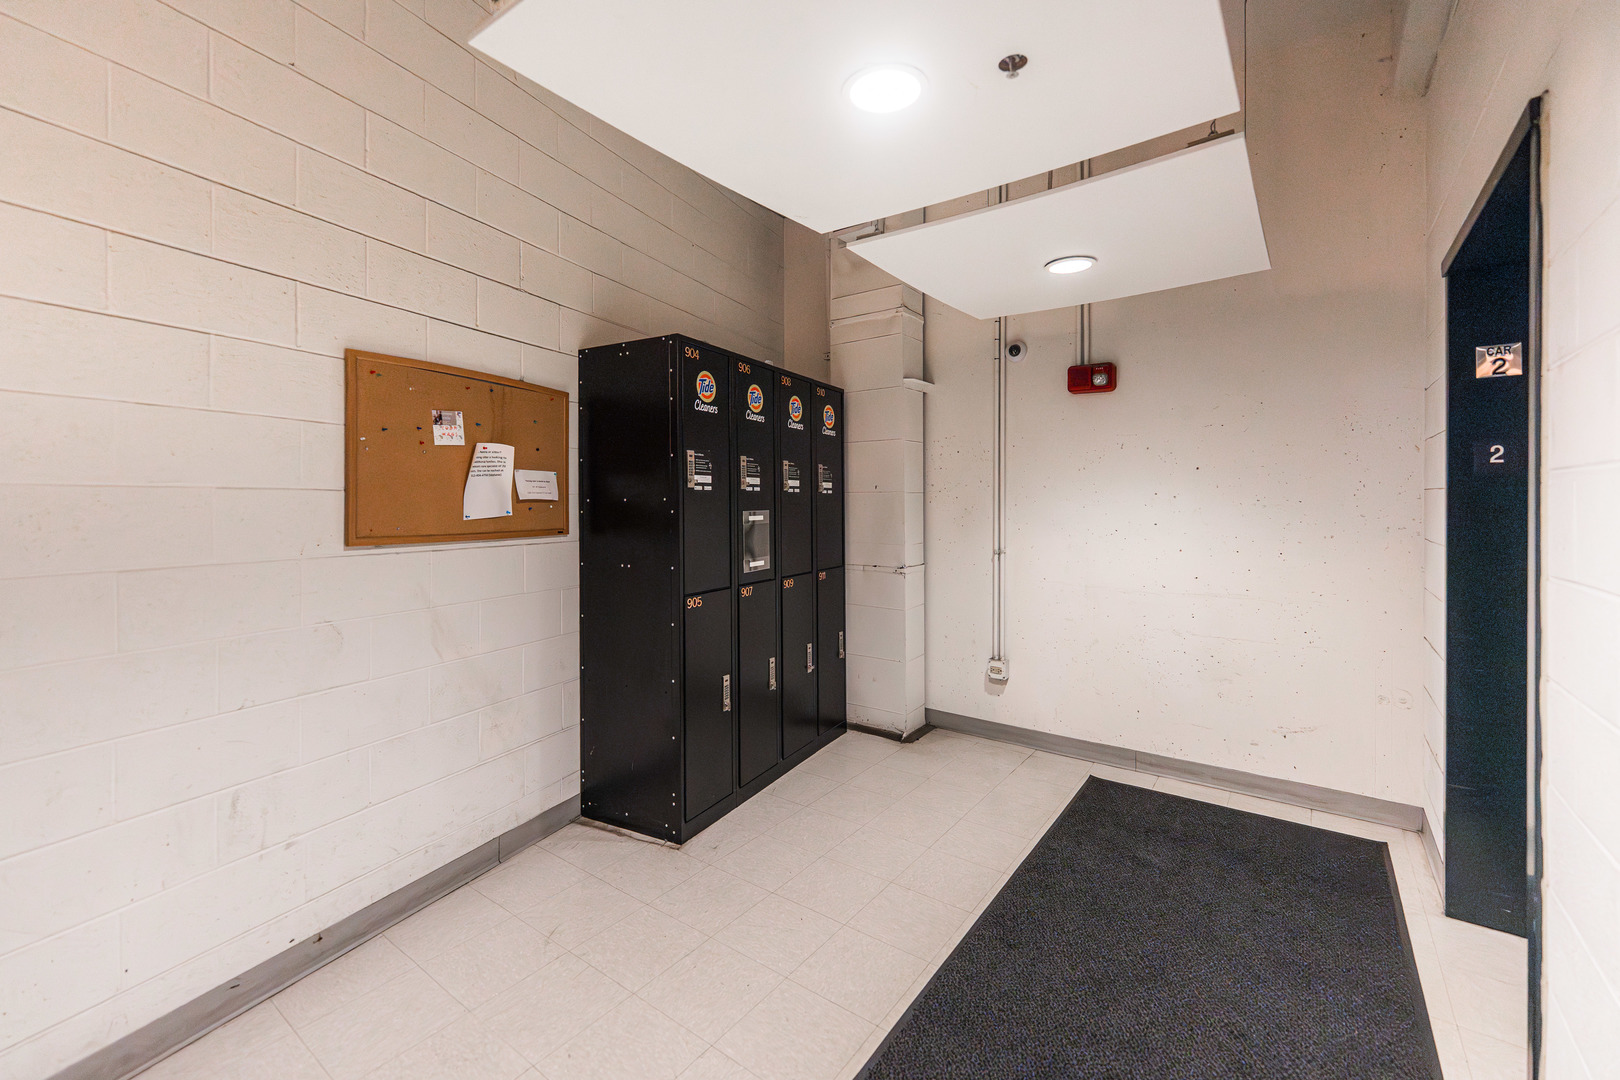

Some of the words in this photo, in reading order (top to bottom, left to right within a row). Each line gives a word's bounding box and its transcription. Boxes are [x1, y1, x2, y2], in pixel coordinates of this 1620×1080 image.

[685, 346, 699, 360] 904
[1486, 345, 1512, 357] CAR
[738, 362, 751, 375] 906
[1492, 358, 1506, 375] 2
[698, 378, 715, 396] Tide
[749, 391, 762, 406] Tide
[694, 399, 719, 414] Cleaners
[790, 401, 801, 416] Tide
[745, 409, 766, 423] Cleaners
[1490, 445, 1504, 463] 2
[783, 578, 794, 589] 909
[741, 586, 753, 597] 907
[687, 596, 703, 609] 905
